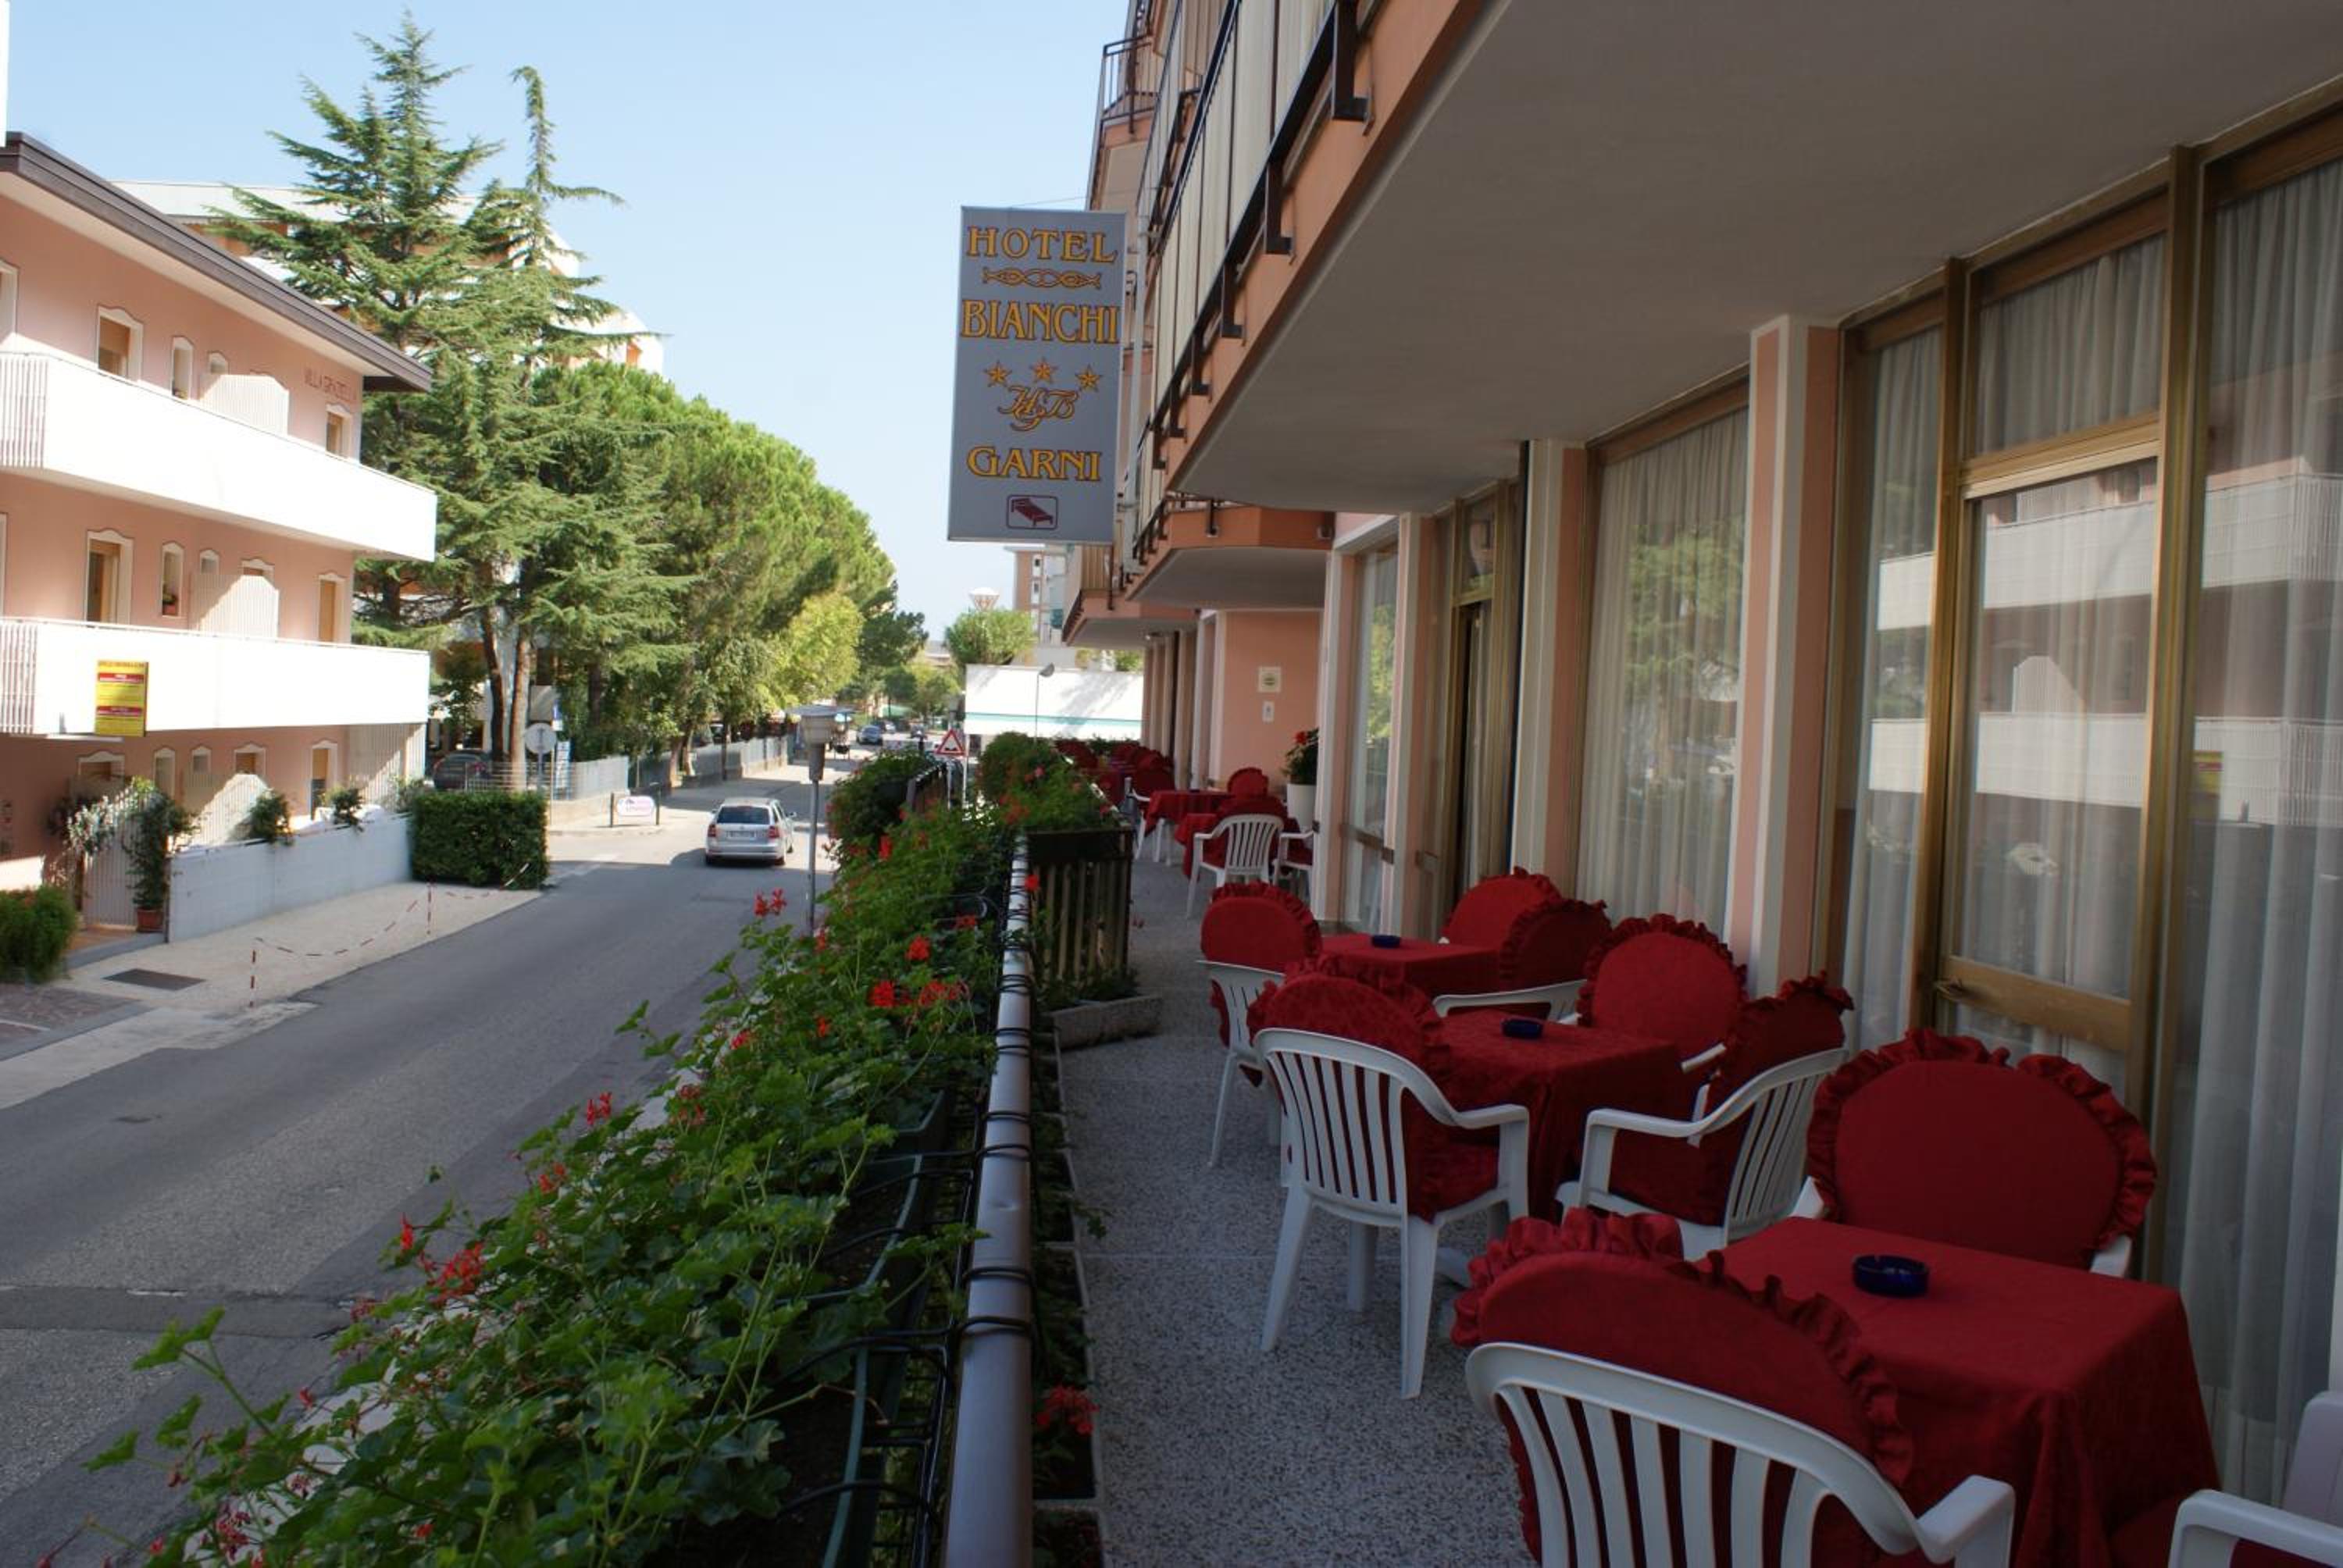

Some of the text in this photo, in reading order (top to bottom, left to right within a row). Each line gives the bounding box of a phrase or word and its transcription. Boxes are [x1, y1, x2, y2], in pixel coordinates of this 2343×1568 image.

[966, 226, 1117, 263] HOTEL
[961, 299, 1121, 344] BIANCHI
[966, 446, 1102, 482] GARNI
